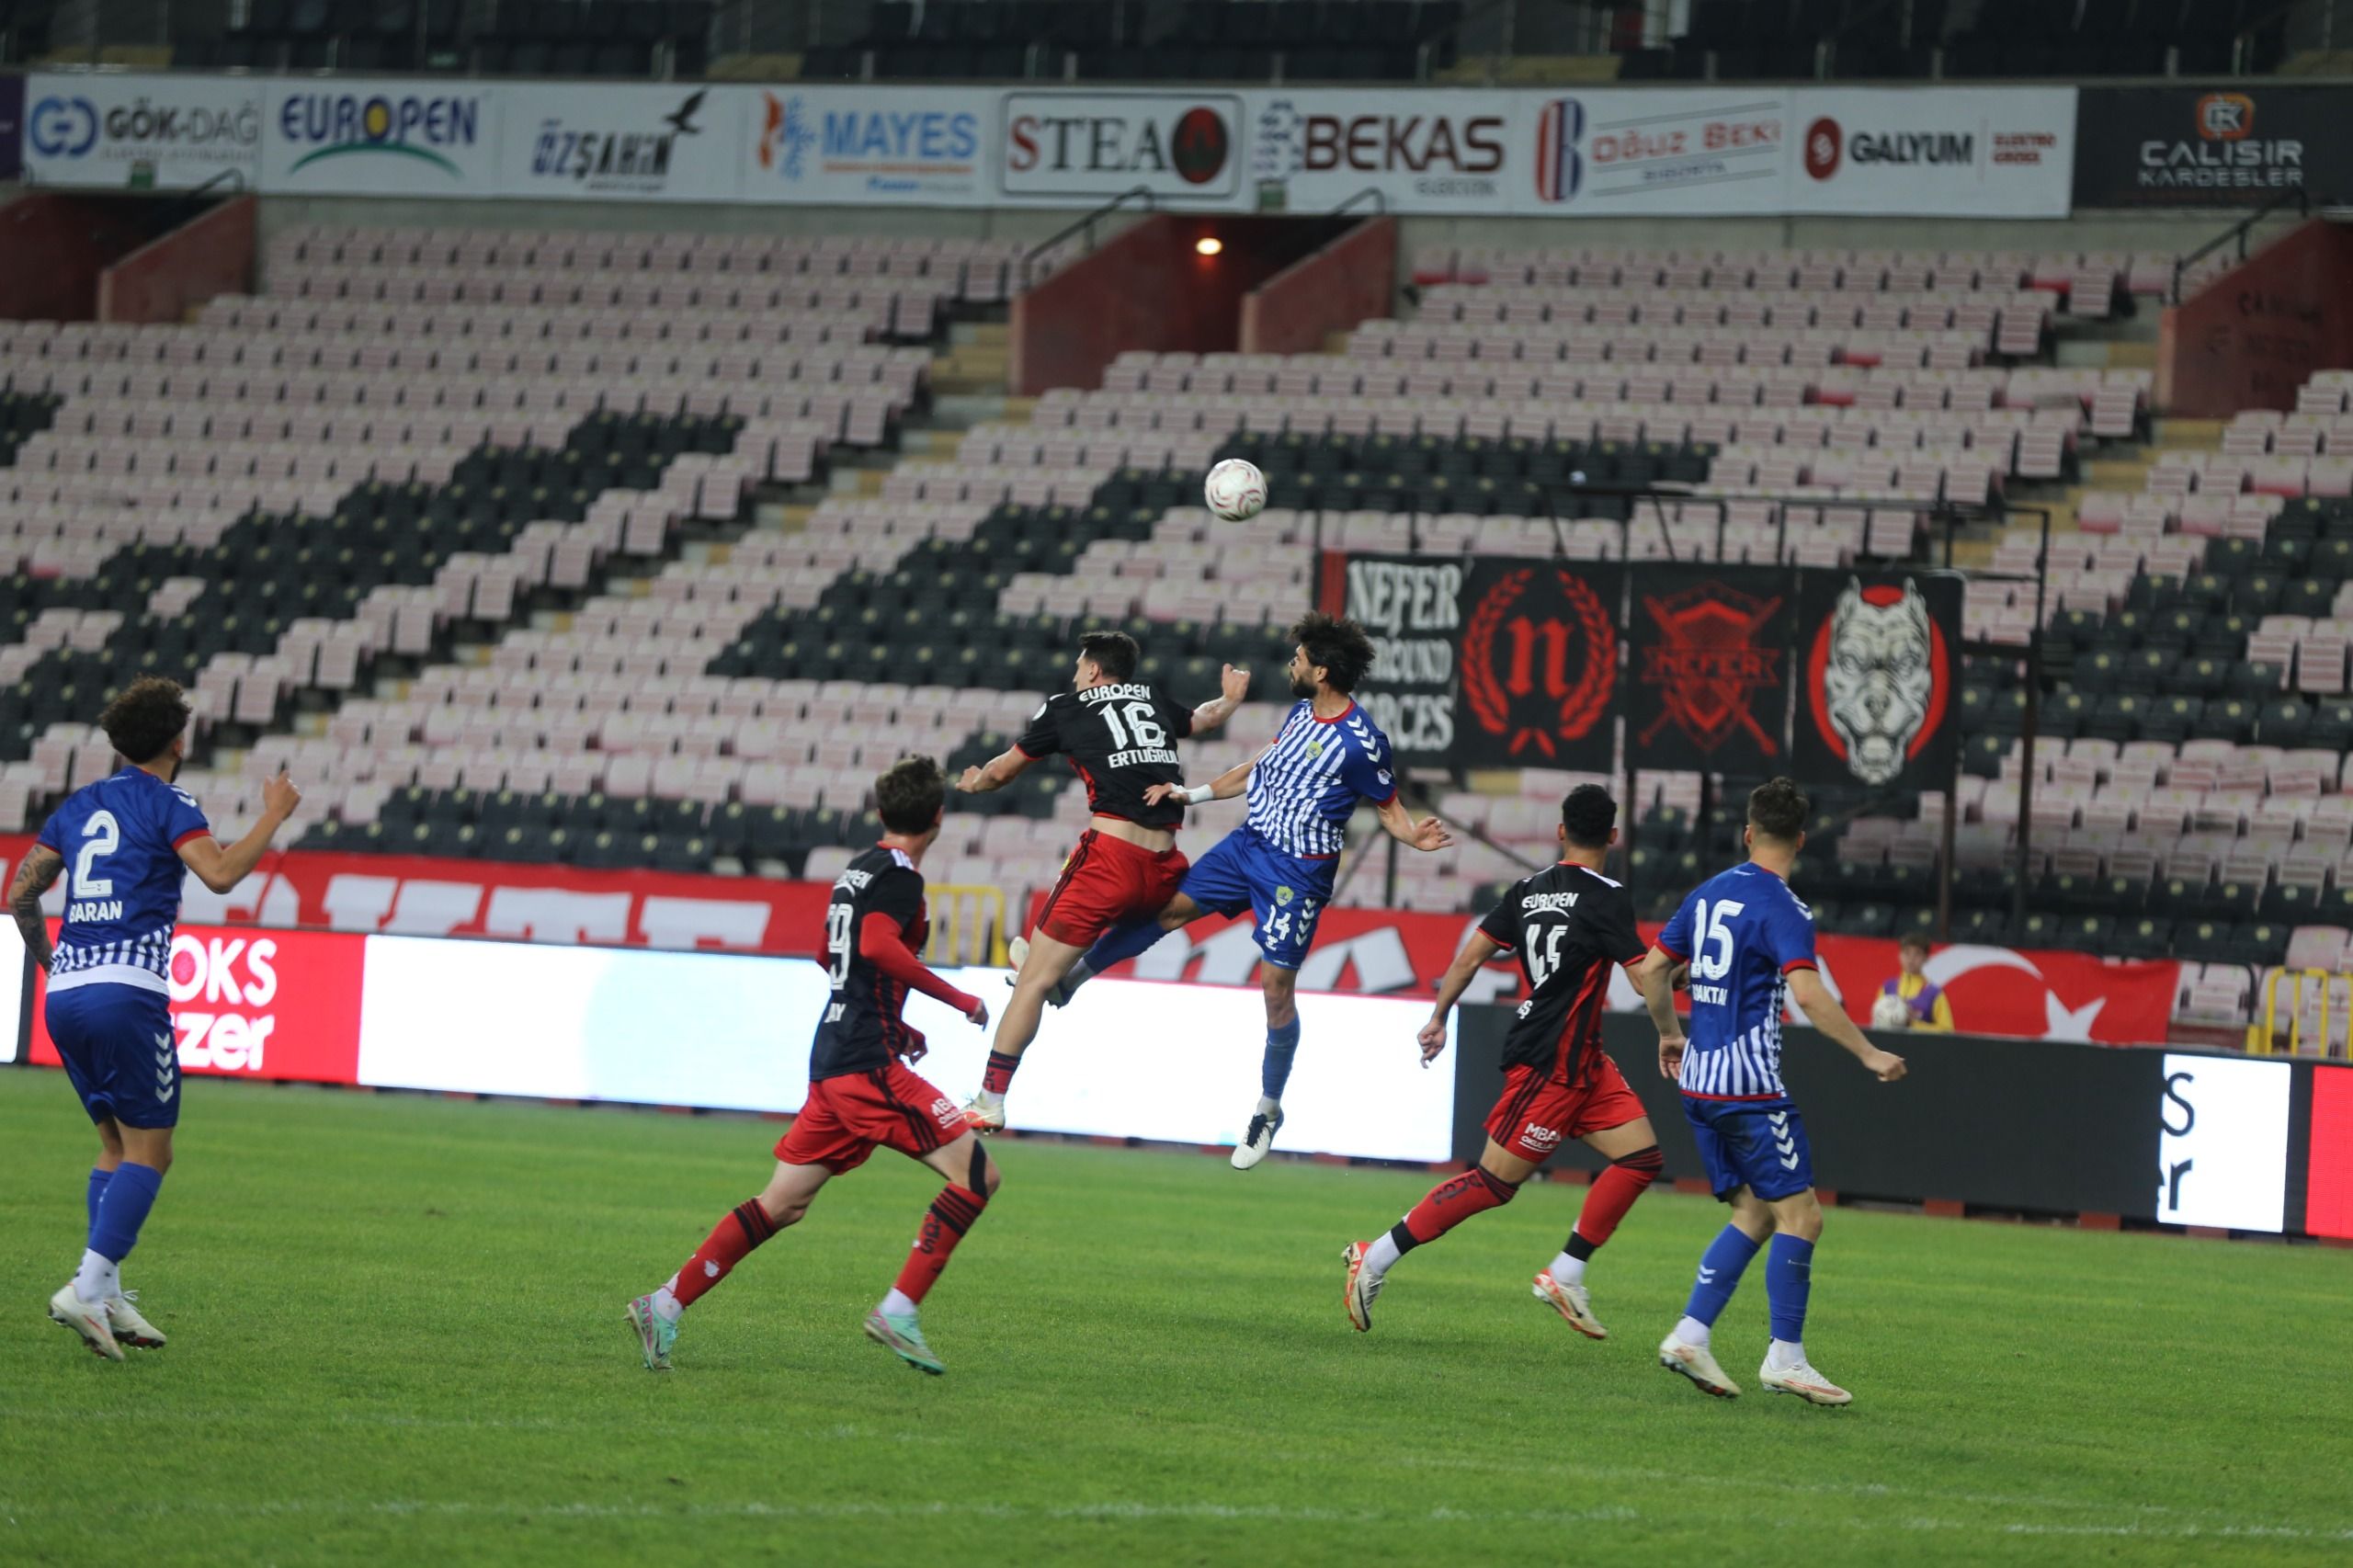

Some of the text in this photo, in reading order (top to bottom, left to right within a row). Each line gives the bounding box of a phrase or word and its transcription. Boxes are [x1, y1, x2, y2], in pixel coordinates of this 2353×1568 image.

[282, 94, 479, 145] EUROPEN
[823, 111, 978, 159] MAYES
[1009, 114, 1167, 174] STEA
[1305, 117, 1505, 173] BEKAS
[1848, 132, 1974, 165] GALYUM
[1347, 560, 1462, 638] NEFER
[1078, 683, 1152, 702] EUROPEN
[1097, 701, 1166, 750] 16
[73, 810, 120, 899] 2
[1262, 903, 1292, 941] 14
[1521, 892, 1580, 909] EUROPEN
[1690, 898, 1745, 981] 15
